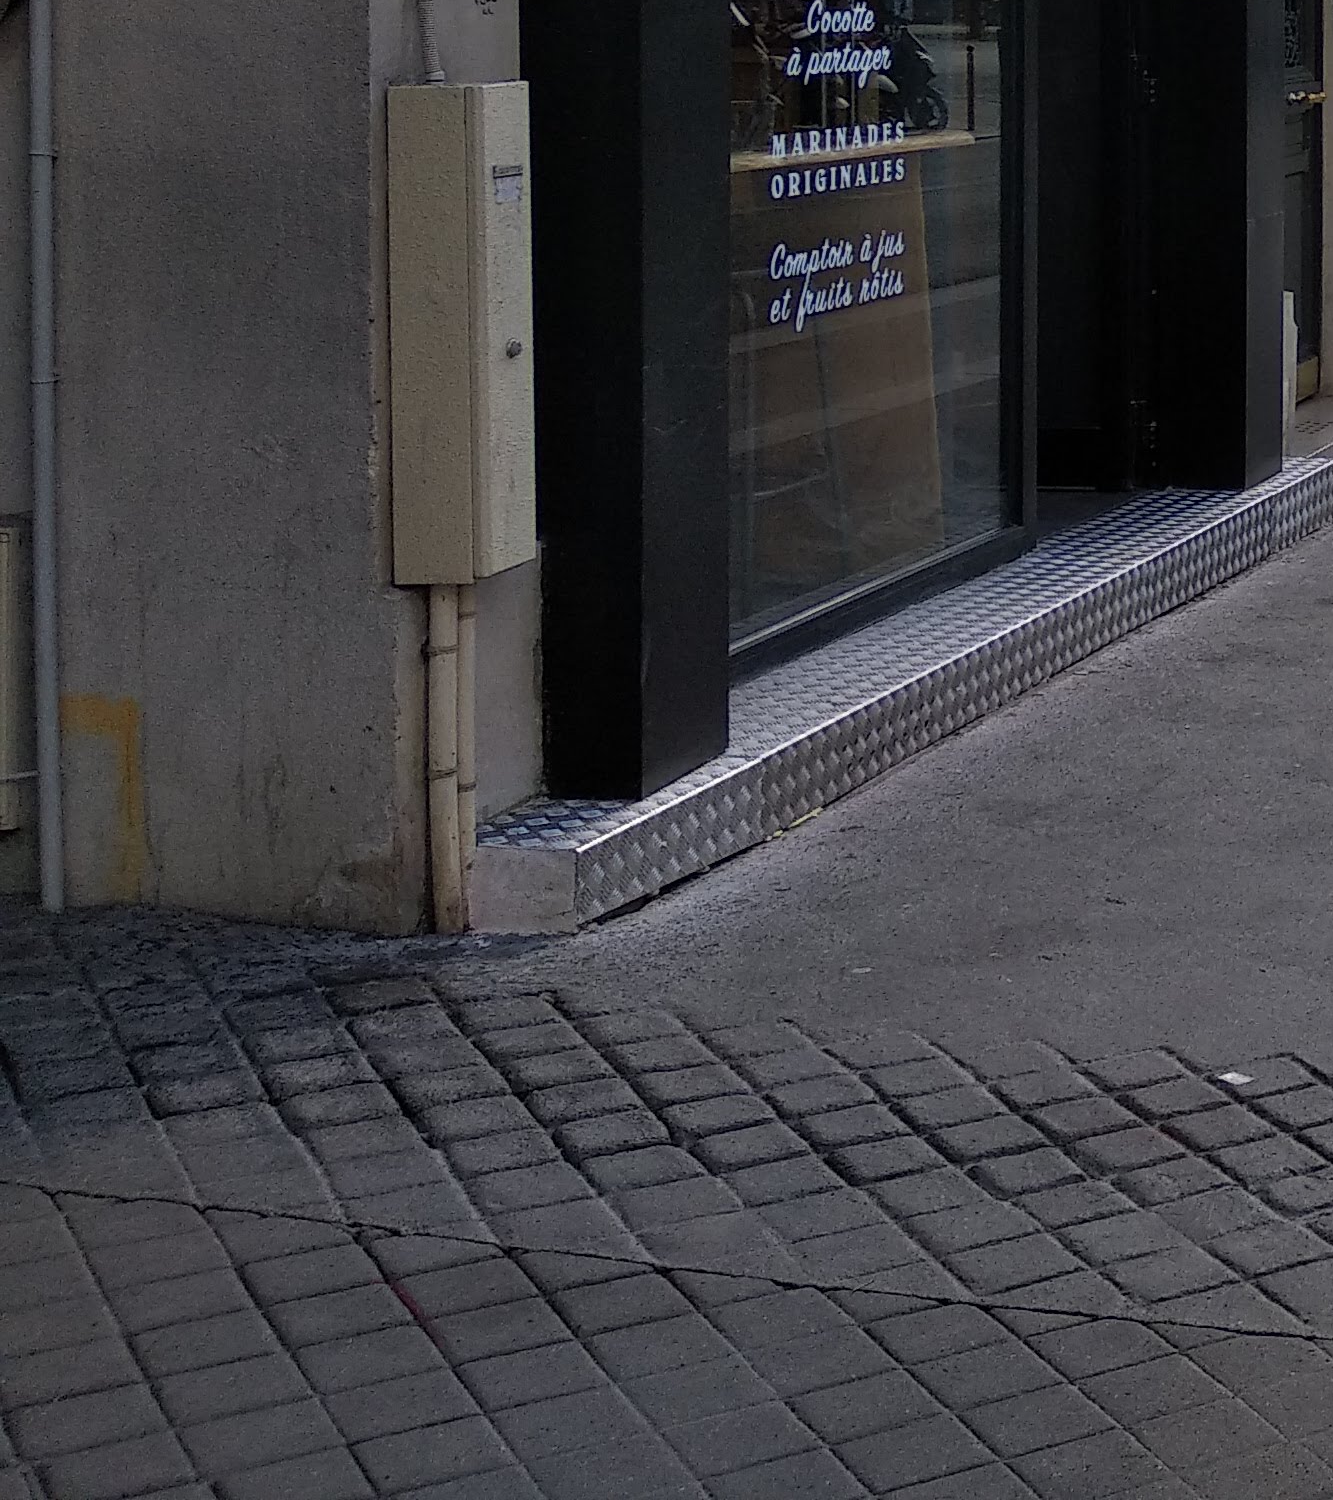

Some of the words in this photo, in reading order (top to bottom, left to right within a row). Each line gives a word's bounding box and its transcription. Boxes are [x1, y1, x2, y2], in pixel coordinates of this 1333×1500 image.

[807, 0, 875, 33] Cocotte
[786, 47, 802, 77] à
[804, 43, 891, 88] partager
[772, 121, 905, 159] MARINADES
[771, 158, 905, 199] ORIGINALES
[771, 238, 854, 285] Comptoir
[860, 233, 873, 261] à
[872, 228, 904, 270] jus
[770, 288, 792, 325] et
[796, 279, 853, 332] fruits
[859, 268, 904, 305] rôtis
